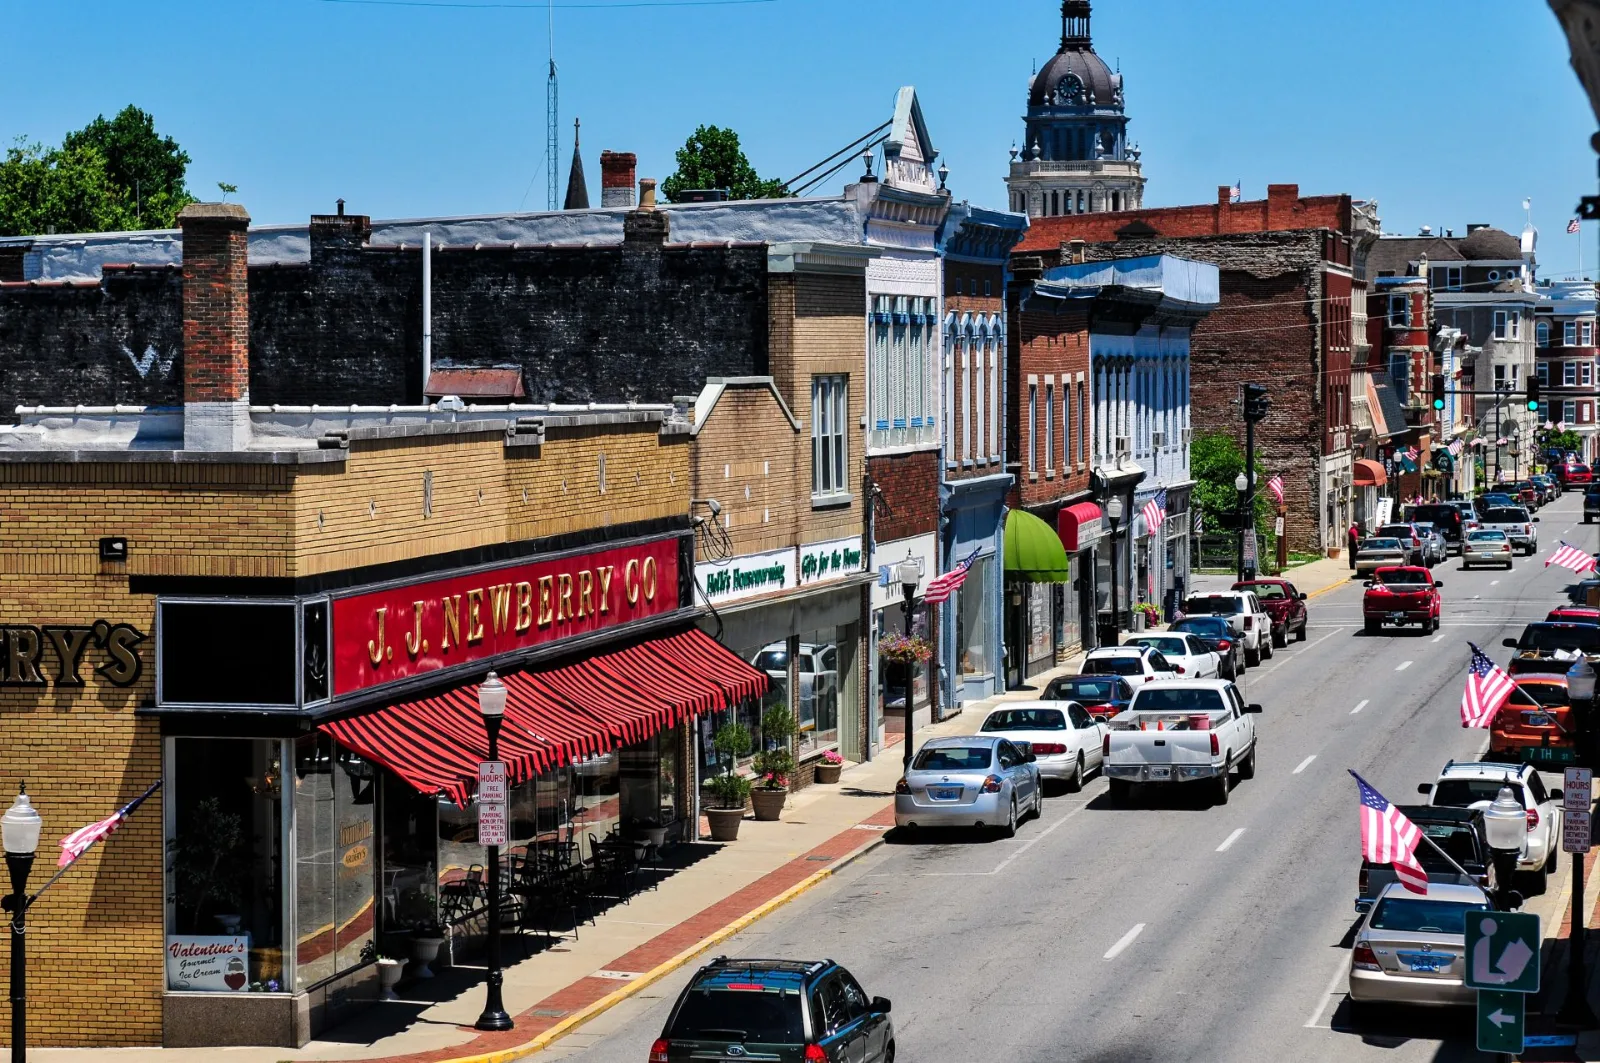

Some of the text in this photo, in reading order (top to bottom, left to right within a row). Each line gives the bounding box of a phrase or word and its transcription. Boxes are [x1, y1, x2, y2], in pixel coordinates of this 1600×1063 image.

[802, 548, 861, 579] Gifts for the Home
[368, 556, 658, 664] J. J. NEWBERRY CO
[0, 619, 149, 687] RY'S
[489, 765, 495, 773] 2
[481, 774, 504, 782] HOURS
[1575, 771, 1581, 780] 2
[1566, 781, 1590, 790] HOURS
[169, 938, 245, 958] Valentine's
[180, 957, 216, 970] Gourmet
[179, 969, 221, 980] Ice Cream
